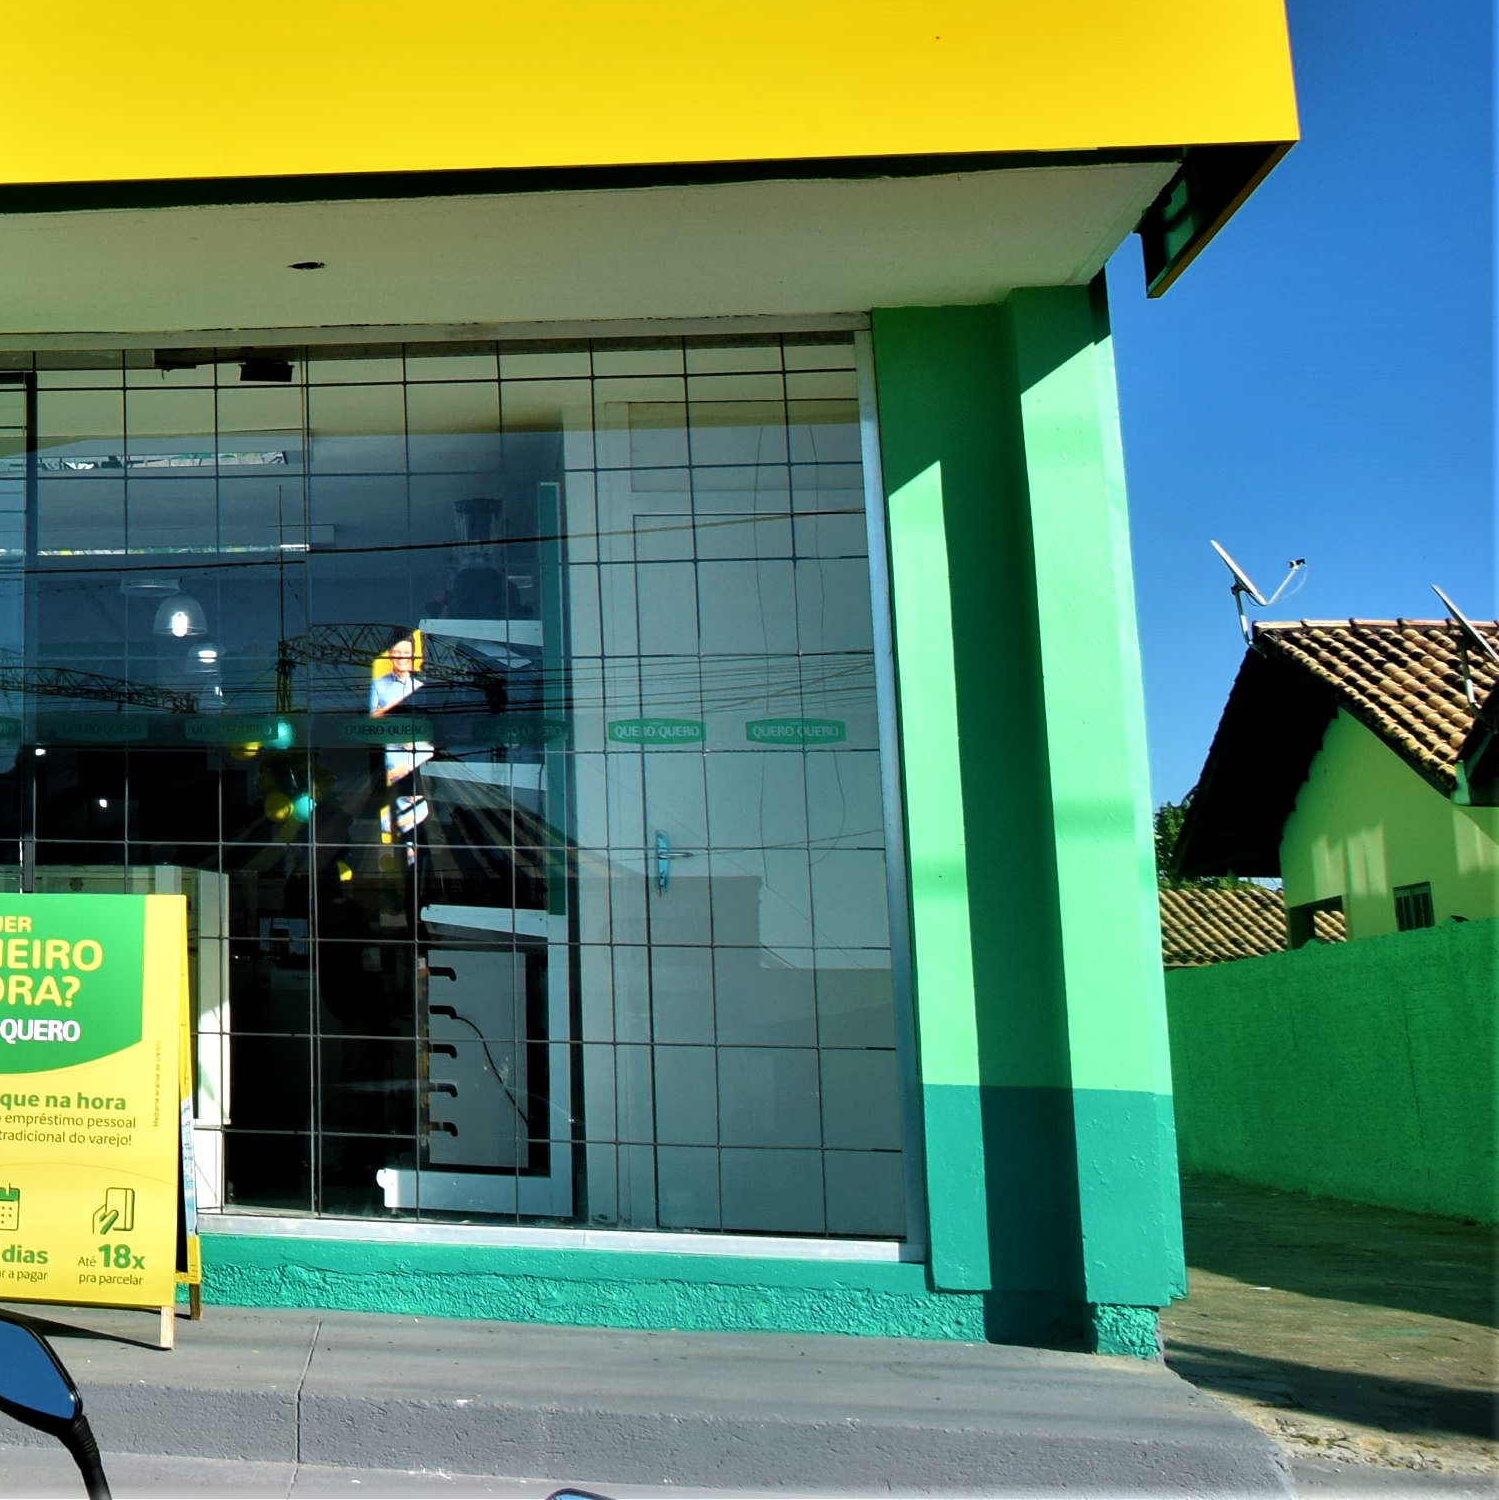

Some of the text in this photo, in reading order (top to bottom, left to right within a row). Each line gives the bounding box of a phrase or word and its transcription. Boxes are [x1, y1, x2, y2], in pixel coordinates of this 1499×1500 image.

[45, 1094, 71, 1108] na
[77, 1092, 126, 1110] hora
[5, 1113, 84, 1128] empréstimo
[87, 1116, 136, 1129] pessoal
[69, 1132, 86, 1144] do
[88, 1135, 132, 1147] varejo!
[2, 1245, 48, 1264] dias
[78, 1244, 145, 1269] Até 18x
[8, 1270, 14, 1278] a
[17, 1270, 48, 1282] pagar
[79, 1273, 143, 1286] pra parcelar
